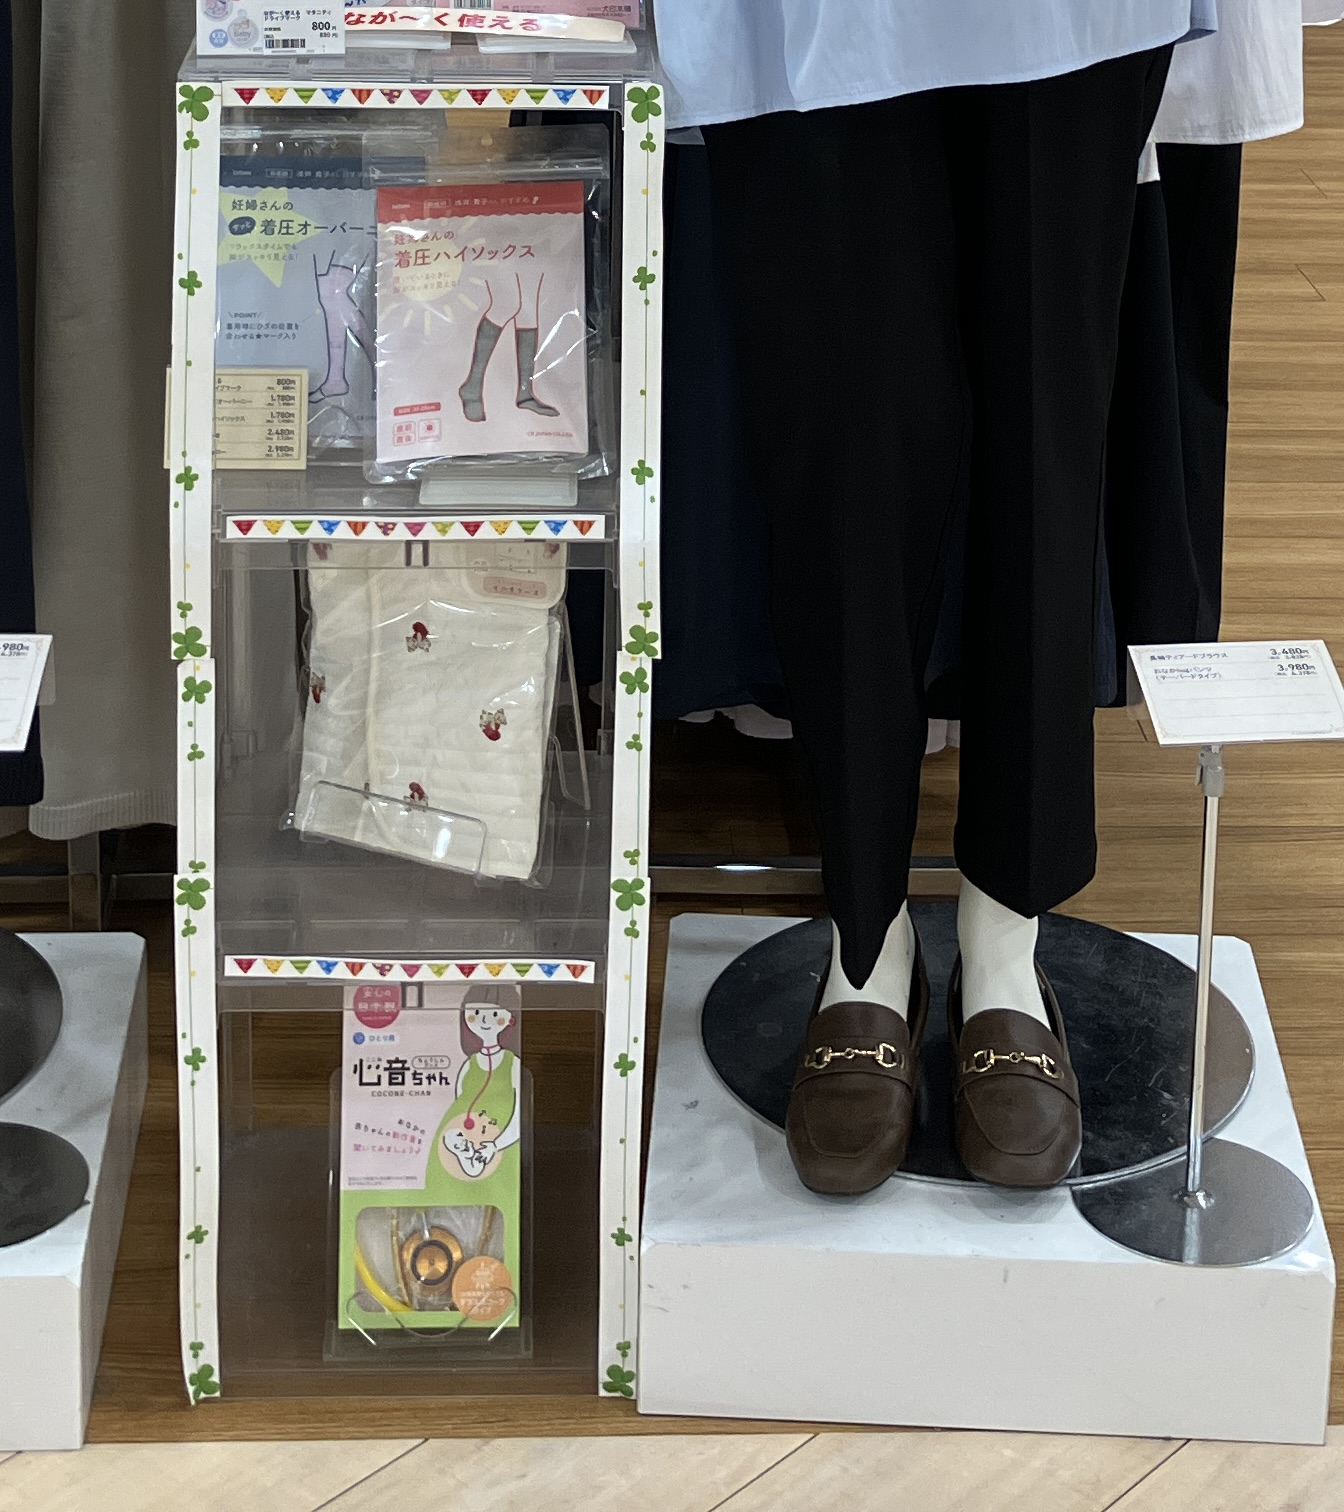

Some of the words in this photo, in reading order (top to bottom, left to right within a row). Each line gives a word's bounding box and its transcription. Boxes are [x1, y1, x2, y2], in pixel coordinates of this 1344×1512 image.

[231, 198, 294, 212] 妊婦さんの
[394, 243, 535, 269] 着圧ハイソックス
[352, 1056, 451, 1087] 心音ちゃん
